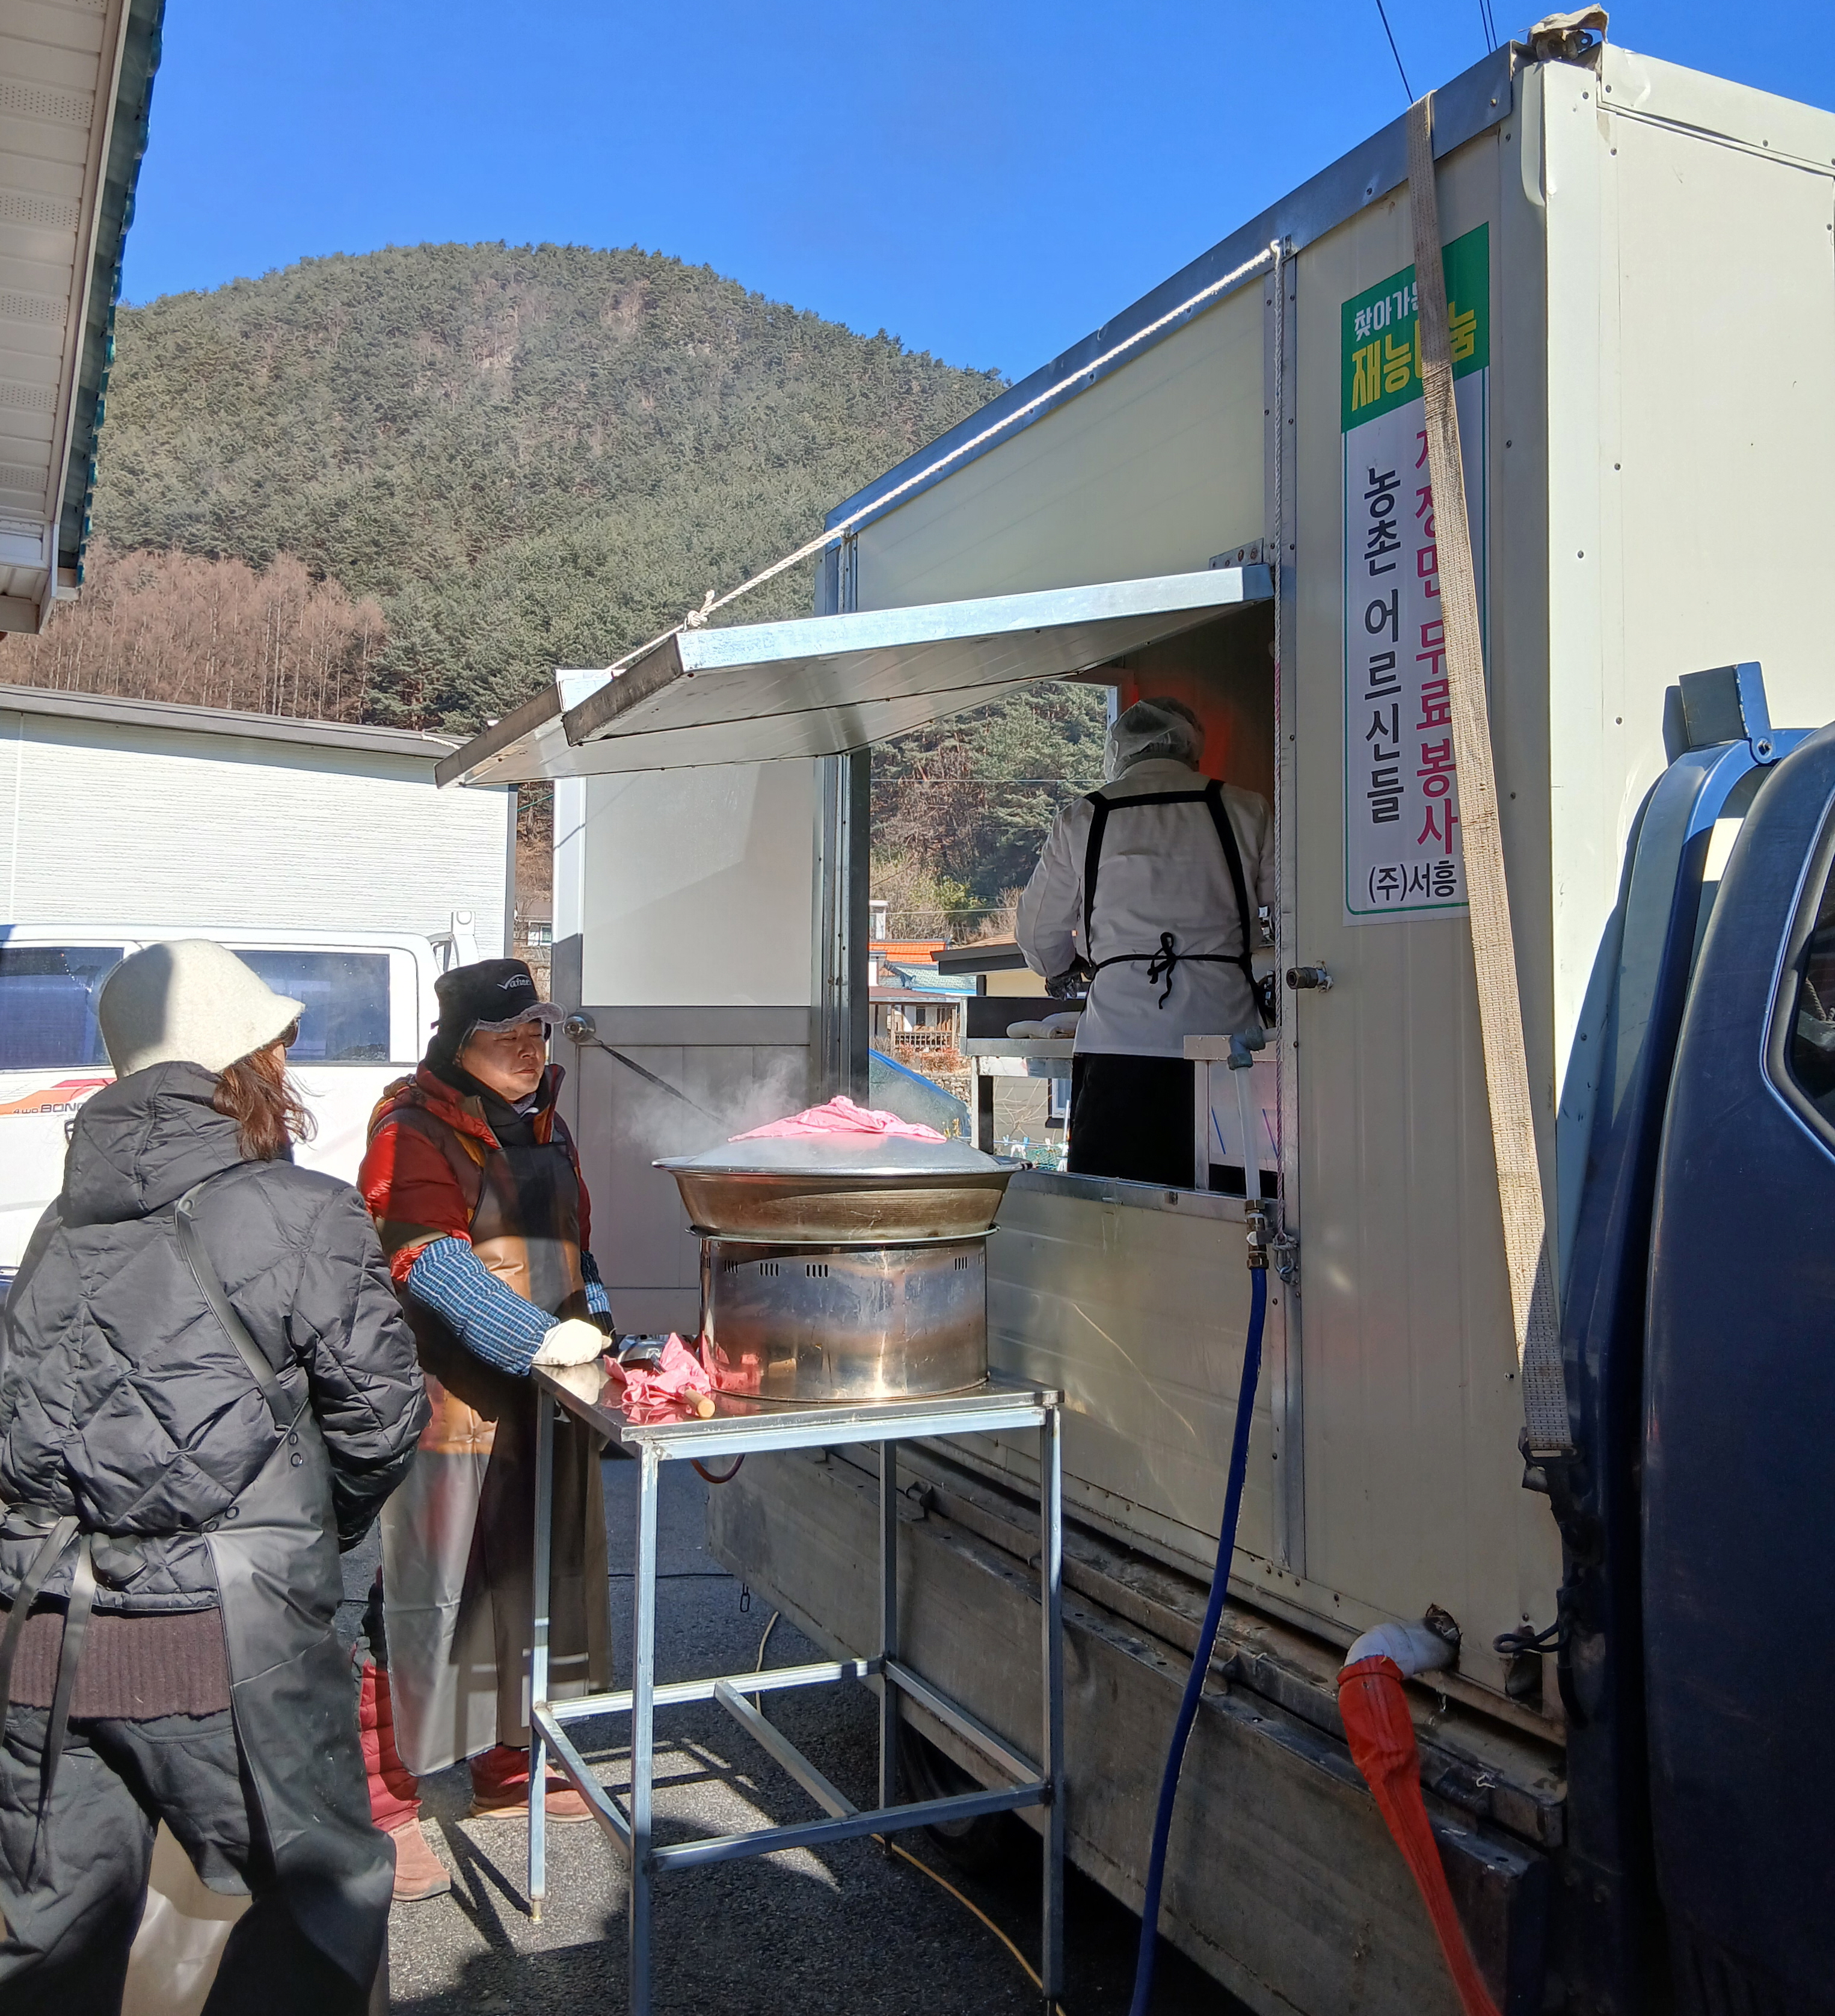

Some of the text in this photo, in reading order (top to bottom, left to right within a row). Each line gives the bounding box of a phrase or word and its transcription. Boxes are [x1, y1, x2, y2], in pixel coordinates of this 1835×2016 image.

[1364, 467, 1404, 824] 농촌 어르신들
[1416, 619, 1458, 854] 무료봉사
[1368, 860, 1457, 903] (주)서흥
